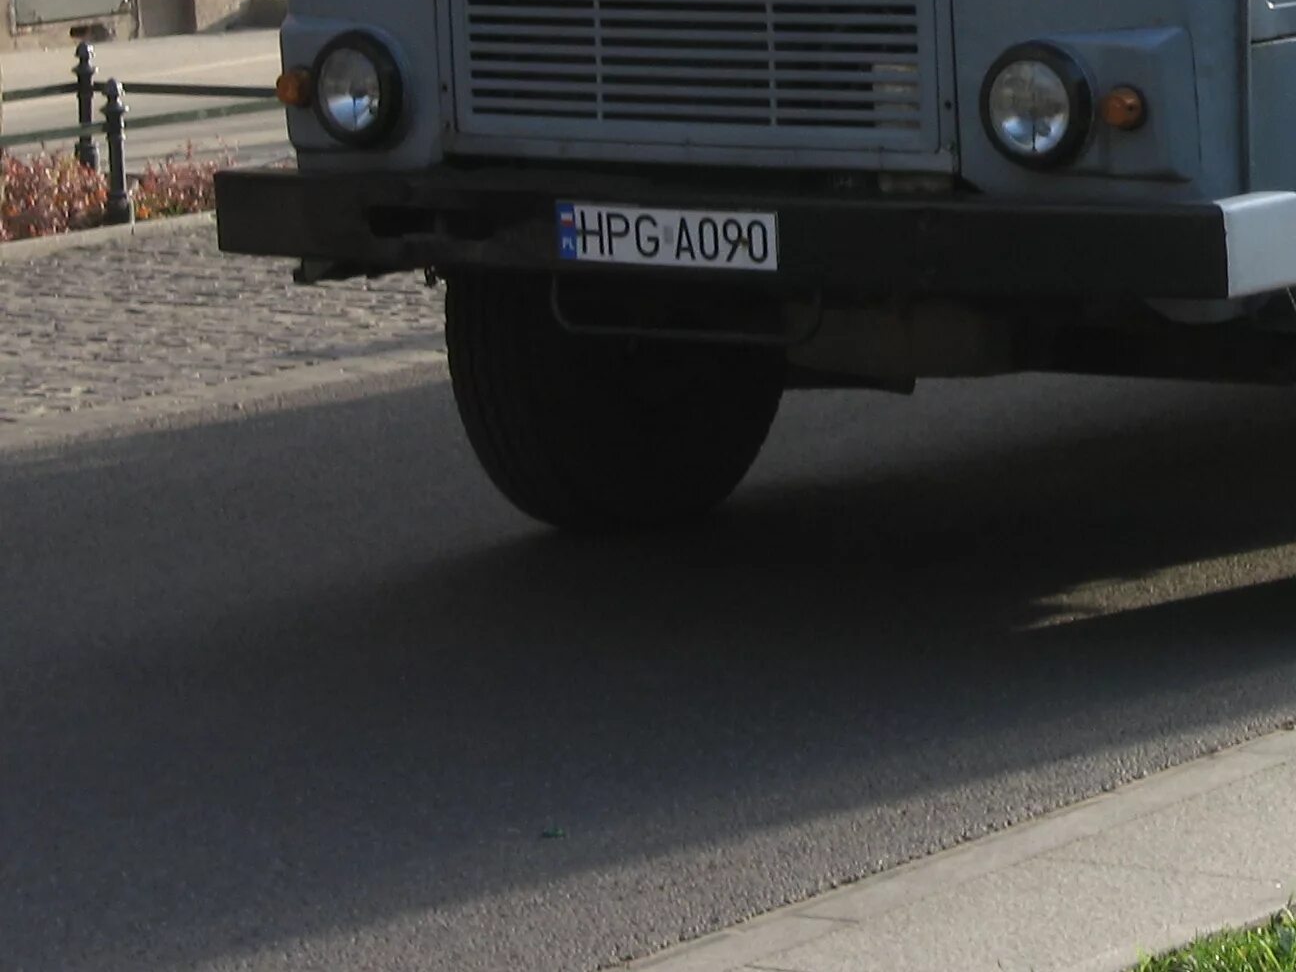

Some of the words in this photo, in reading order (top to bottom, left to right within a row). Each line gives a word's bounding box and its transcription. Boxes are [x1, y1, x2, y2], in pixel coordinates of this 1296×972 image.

[562, 237, 575, 250] PL
[579, 210, 660, 258] HPG
[675, 216, 769, 264] A090
